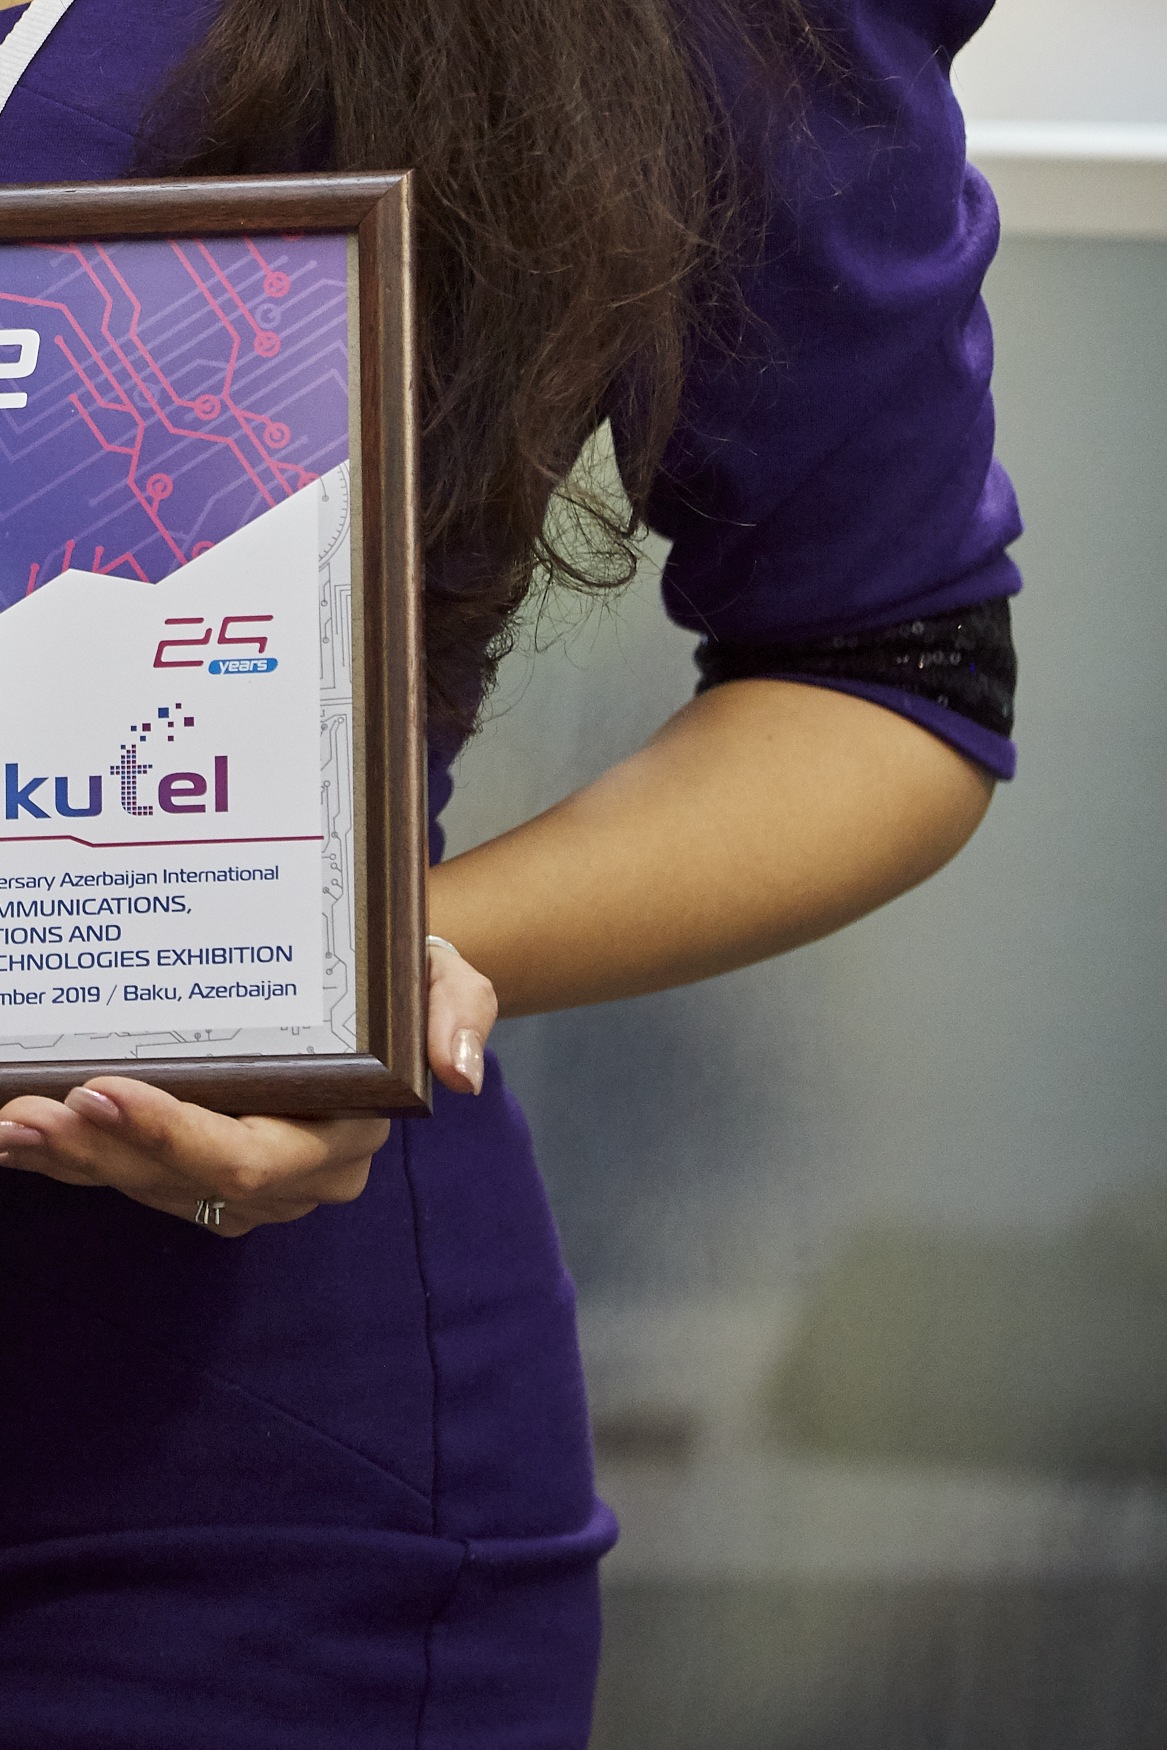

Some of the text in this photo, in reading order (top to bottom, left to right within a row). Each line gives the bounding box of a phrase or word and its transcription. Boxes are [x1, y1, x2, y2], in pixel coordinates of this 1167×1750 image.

[153, 614, 274, 669] 25
[218, 656, 268, 674] years
[59, 868, 160, 888] Azerbaijan
[162, 865, 279, 885] International
[68, 924, 122, 943] AND
[156, 944, 294, 968] EXHIBITION
[51, 986, 101, 1005] 2019
[106, 984, 118, 1007] /
[123, 983, 182, 1003] Baku,
[187, 980, 298, 1002] Azerbaijan
